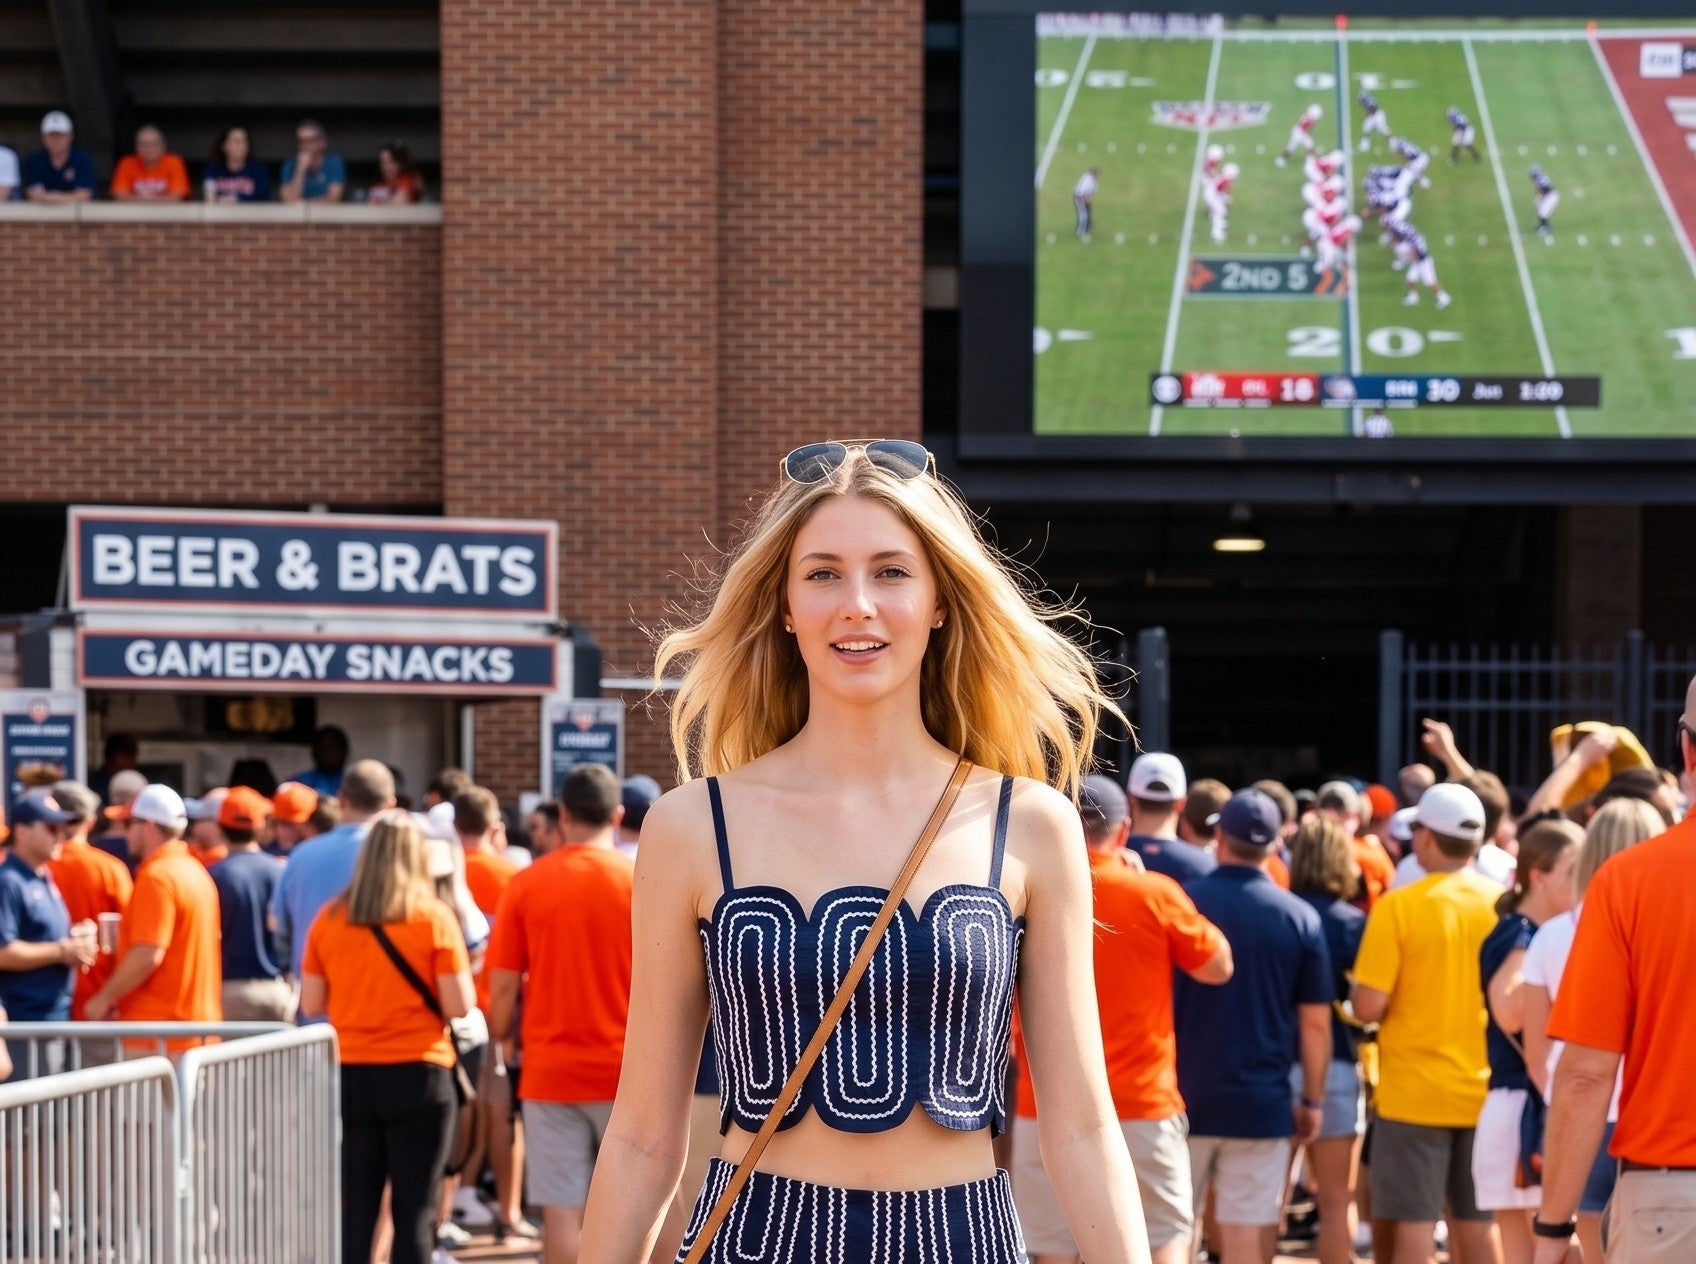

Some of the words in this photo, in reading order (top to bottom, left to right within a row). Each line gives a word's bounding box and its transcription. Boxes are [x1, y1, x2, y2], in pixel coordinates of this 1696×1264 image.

[1221, 262, 1282, 290] 2ND
[1287, 263, 1309, 290] 5
[92, 533, 260, 590] BEER
[275, 538, 320, 591] &
[337, 540, 537, 597] BRATS
[124, 639, 336, 680] GAMEDAY
[345, 643, 515, 684] SNACKS
